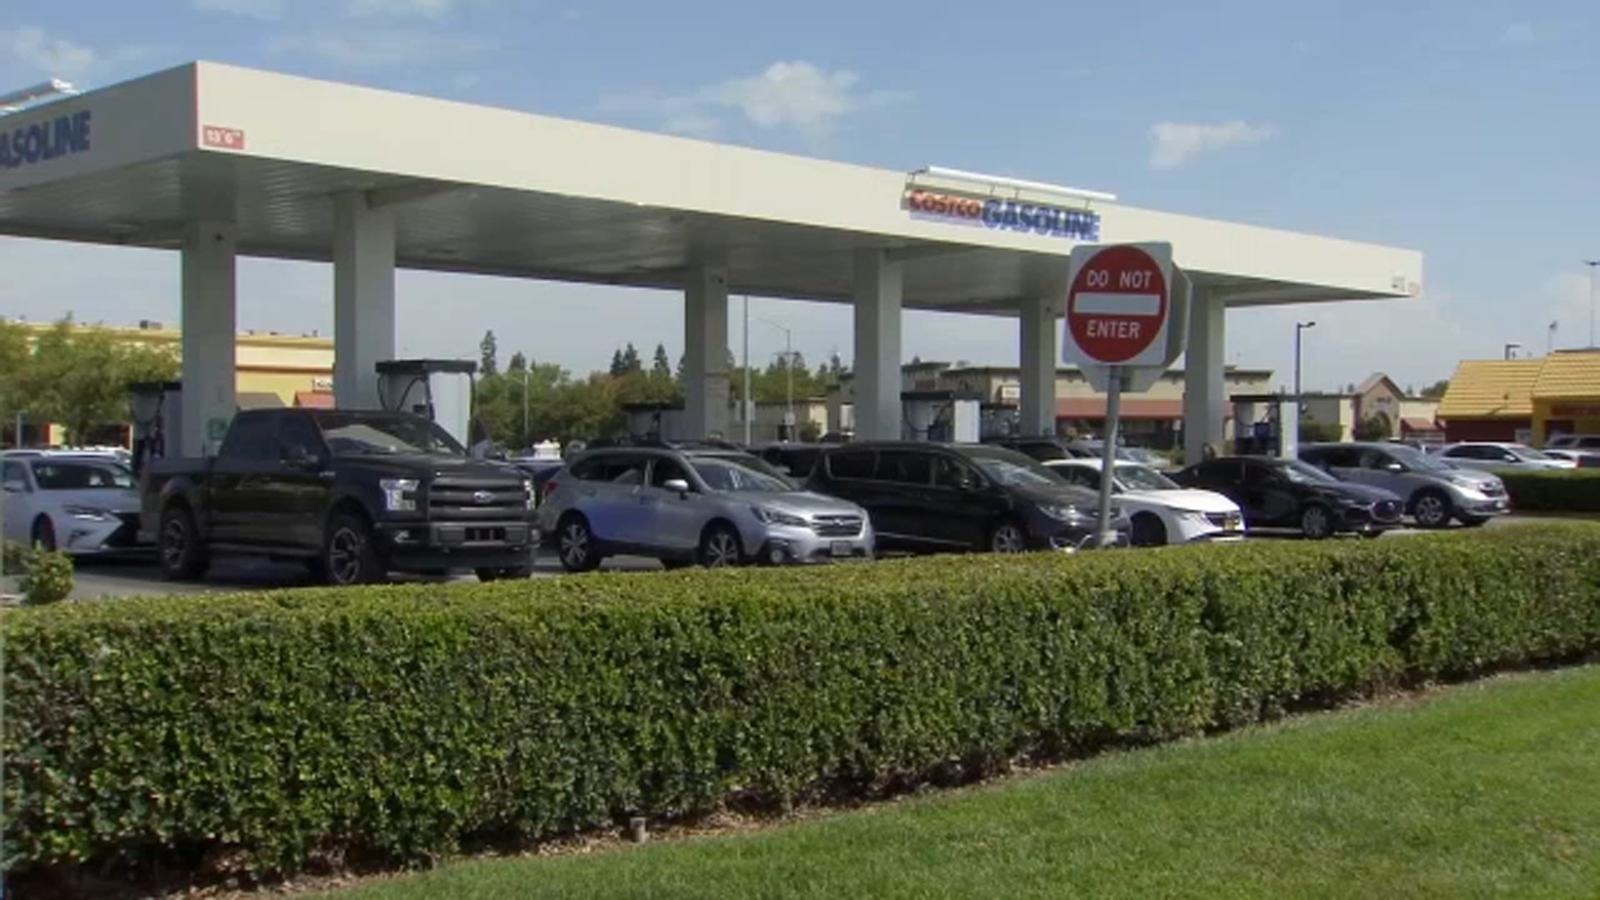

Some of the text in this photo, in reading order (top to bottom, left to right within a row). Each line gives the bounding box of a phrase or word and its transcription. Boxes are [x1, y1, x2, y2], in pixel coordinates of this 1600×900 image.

[908, 189, 1100, 241] COSTCO GASOLINE
[1086, 270, 1153, 289] DO NOT
[1086, 319, 1141, 340] ENTER
